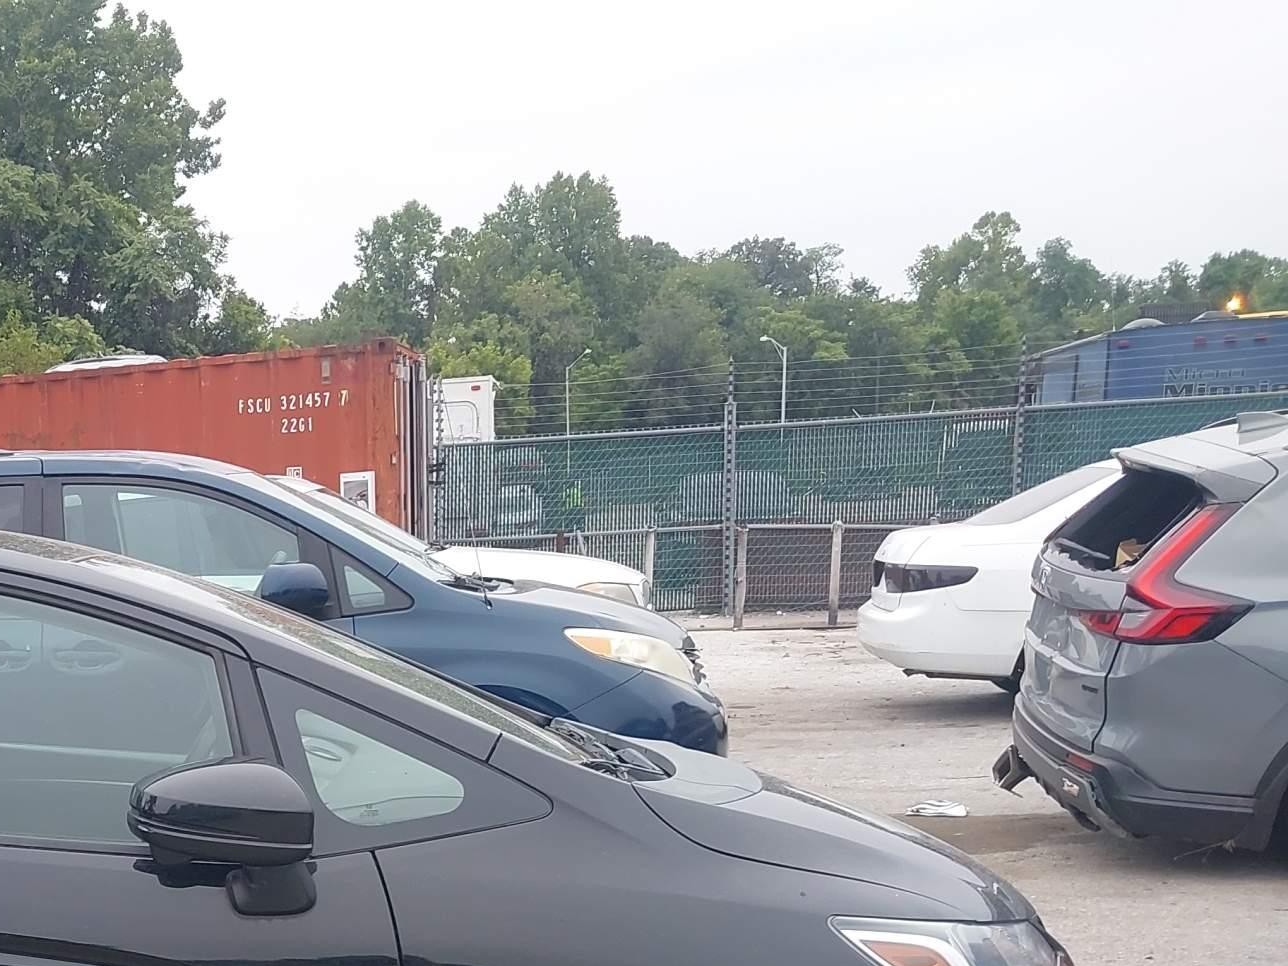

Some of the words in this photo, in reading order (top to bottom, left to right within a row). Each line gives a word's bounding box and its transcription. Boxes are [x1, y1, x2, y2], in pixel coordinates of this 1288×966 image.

[238, 397, 271, 414] FSCU
[280, 391, 330, 411] 321457
[338, 389, 349, 407] 7
